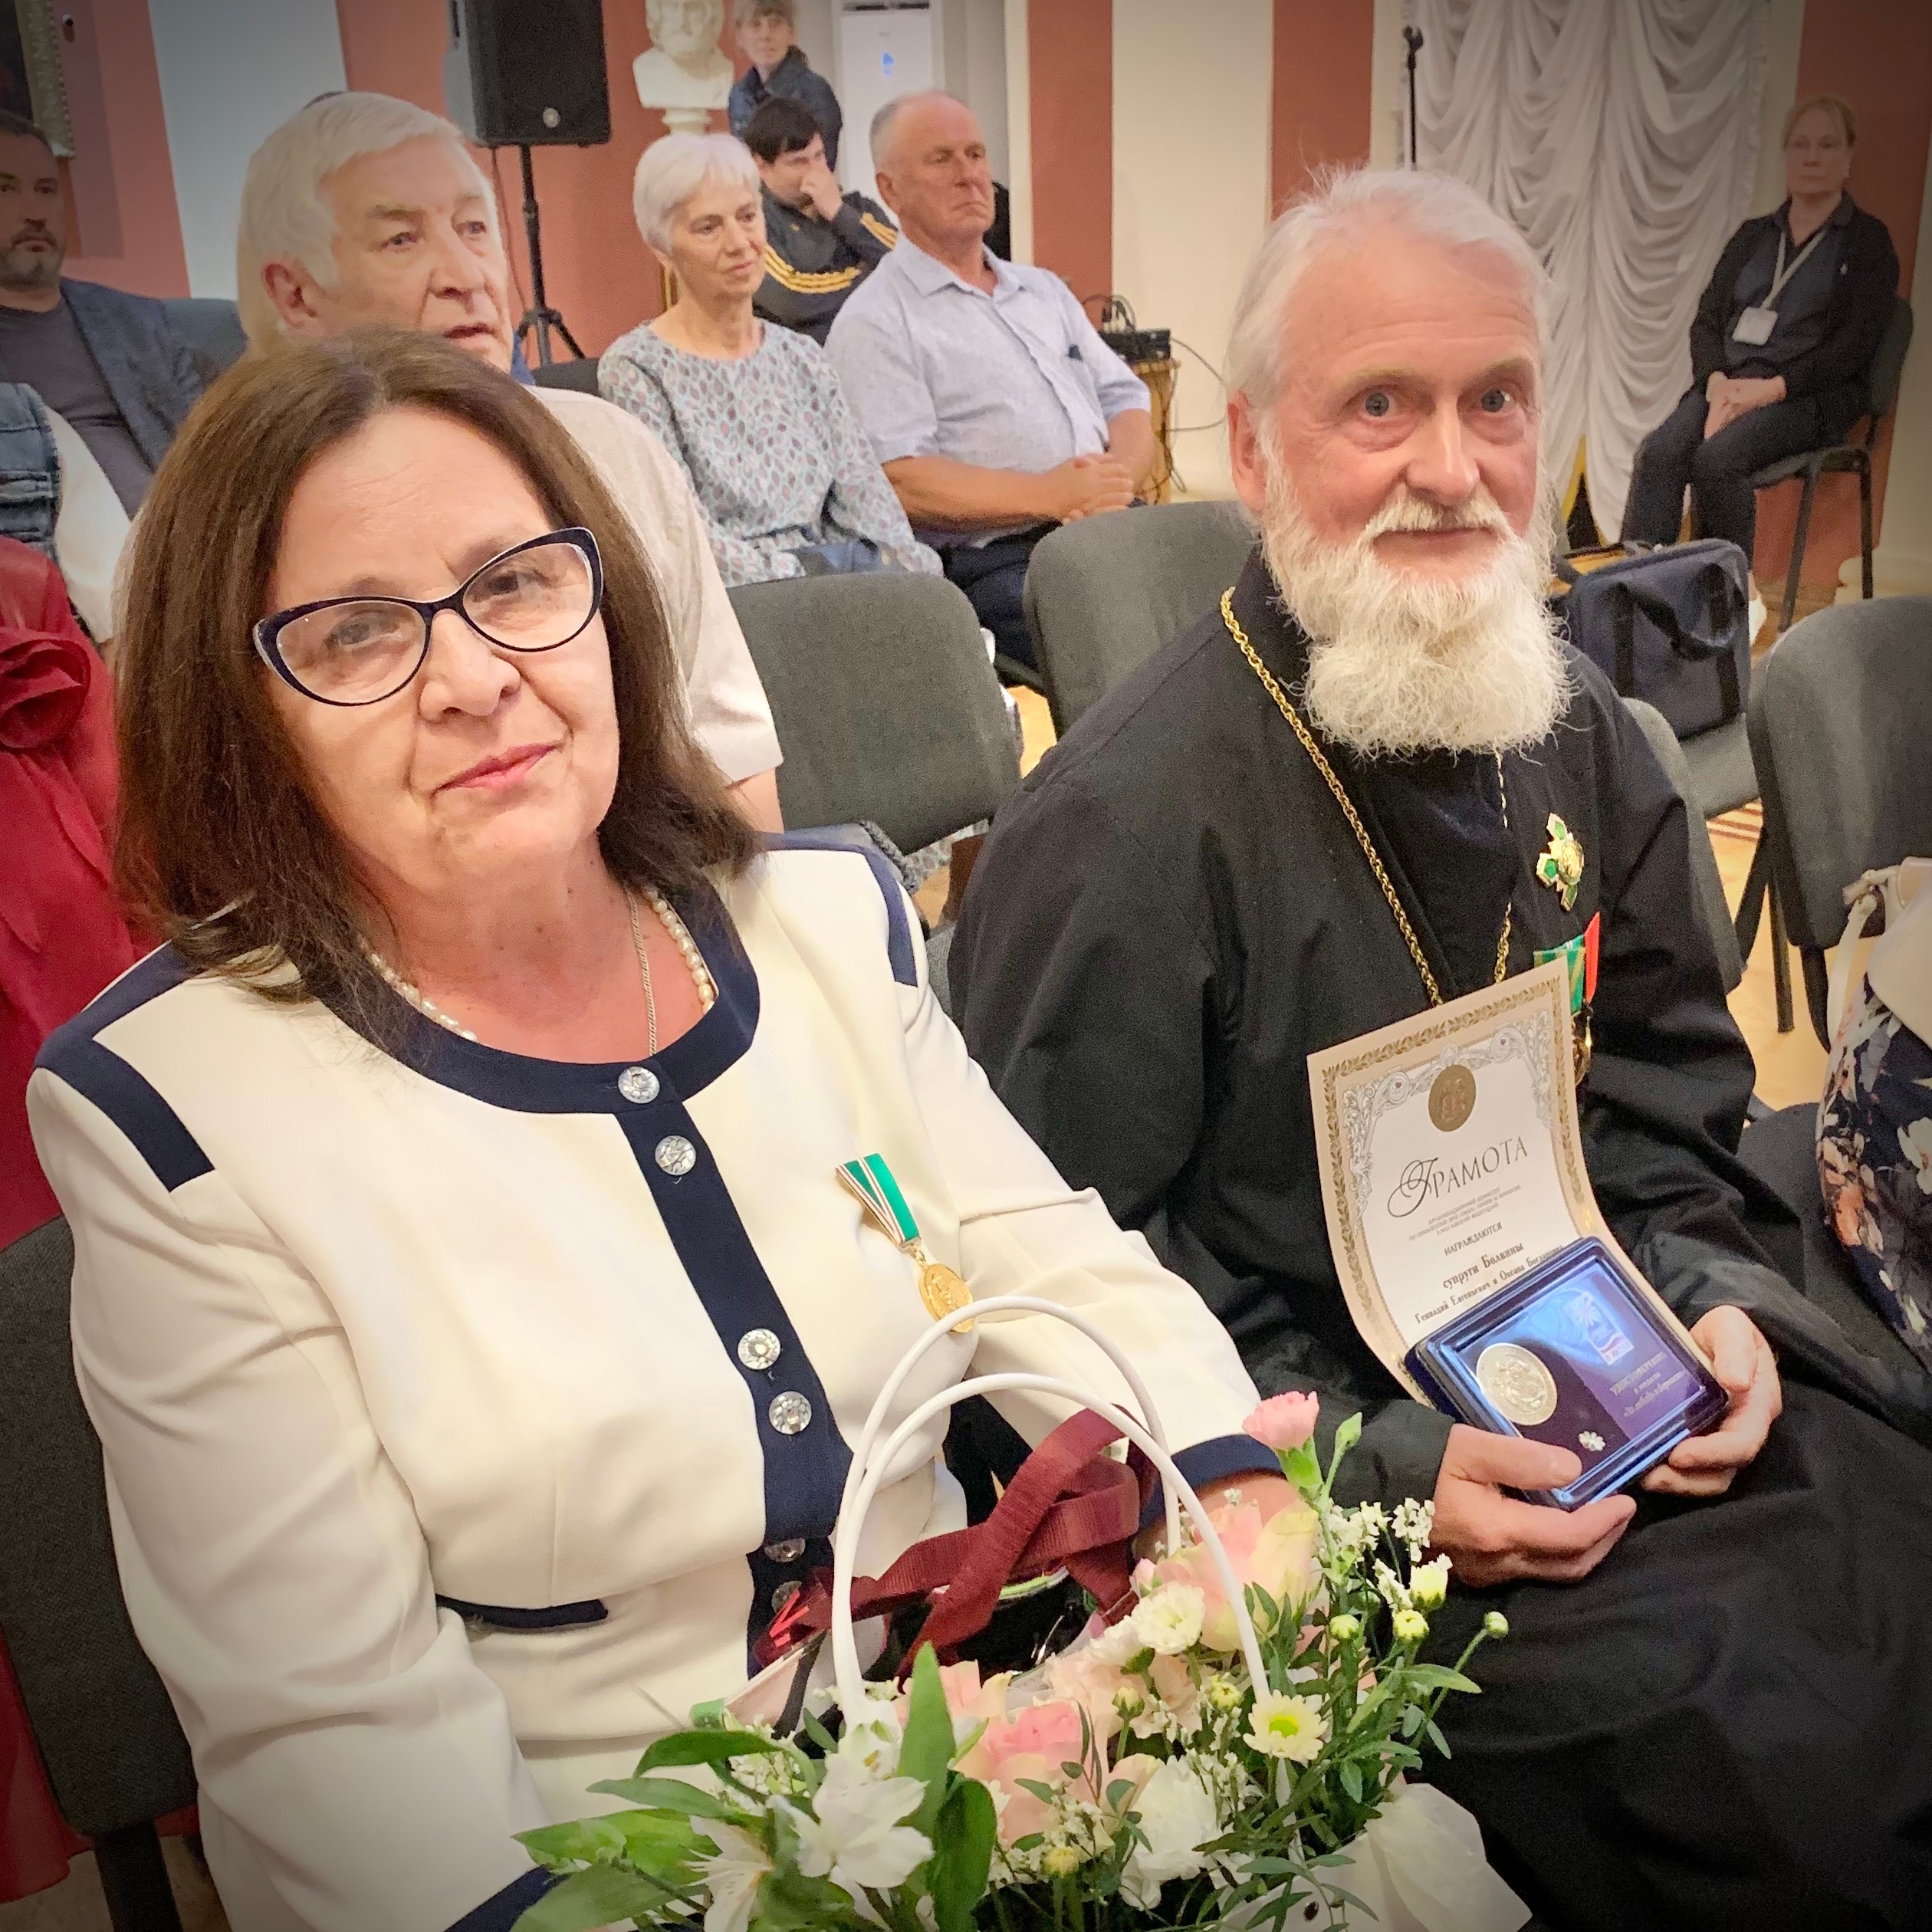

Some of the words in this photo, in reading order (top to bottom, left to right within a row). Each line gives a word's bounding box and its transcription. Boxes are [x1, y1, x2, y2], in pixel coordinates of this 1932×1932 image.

[1444, 1221, 1503, 1256] НАГРАЖДАЮТСЯ
[1414, 1300, 1449, 1324] Геннадий
[1499, 1265, 1525, 1280] Оксана
[1443, 1265, 1479, 1290] супруги
